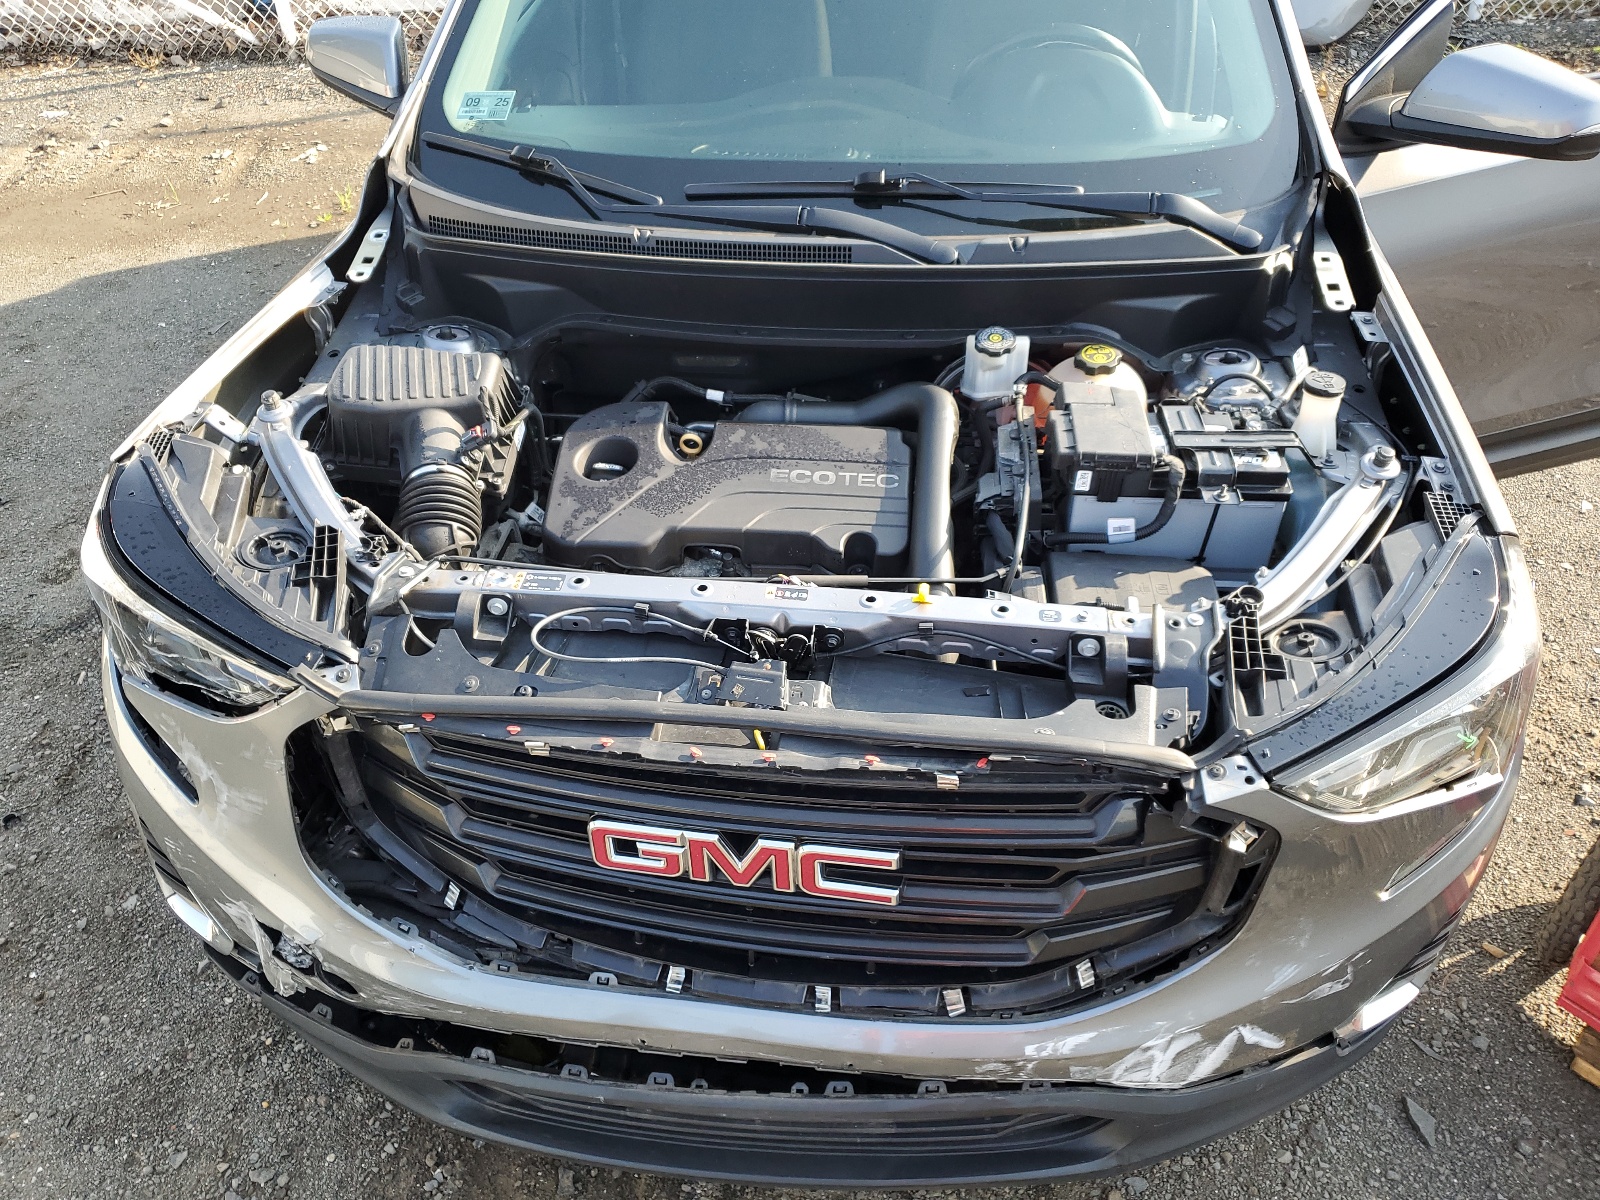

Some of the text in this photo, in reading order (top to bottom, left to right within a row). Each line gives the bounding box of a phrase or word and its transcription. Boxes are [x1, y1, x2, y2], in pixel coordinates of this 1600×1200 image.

[465, 97, 511, 107] 09 25
[769, 468, 899, 488] ECOTEC
[587, 819, 900, 906] GMC
